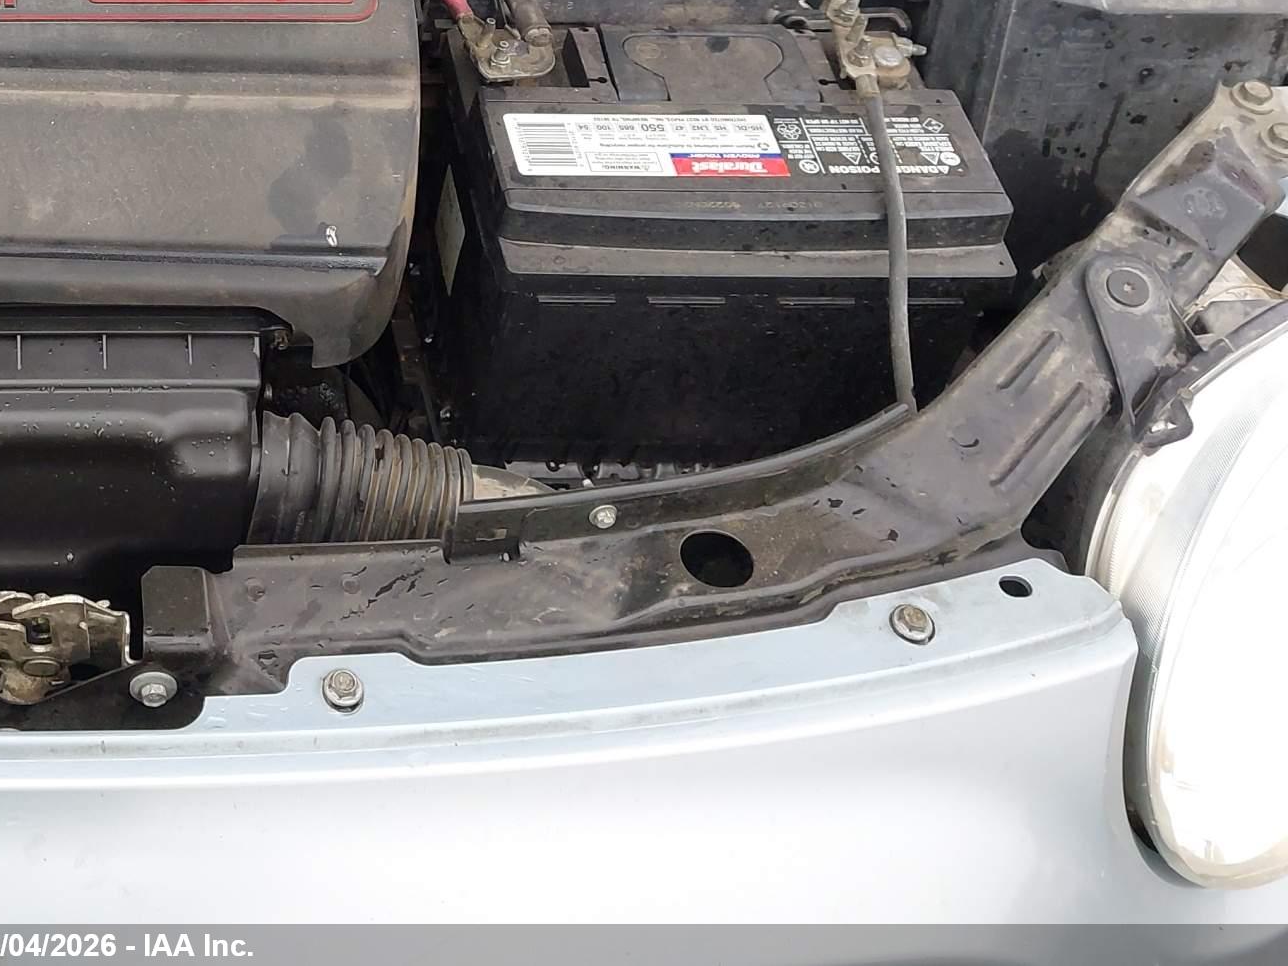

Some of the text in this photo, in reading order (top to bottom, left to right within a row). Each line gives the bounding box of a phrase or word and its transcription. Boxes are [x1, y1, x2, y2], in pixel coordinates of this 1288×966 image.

[641, 123, 665, 133] 550
[690, 161, 769, 173] Duralast
[828, 165, 939, 174] DANG POISON
